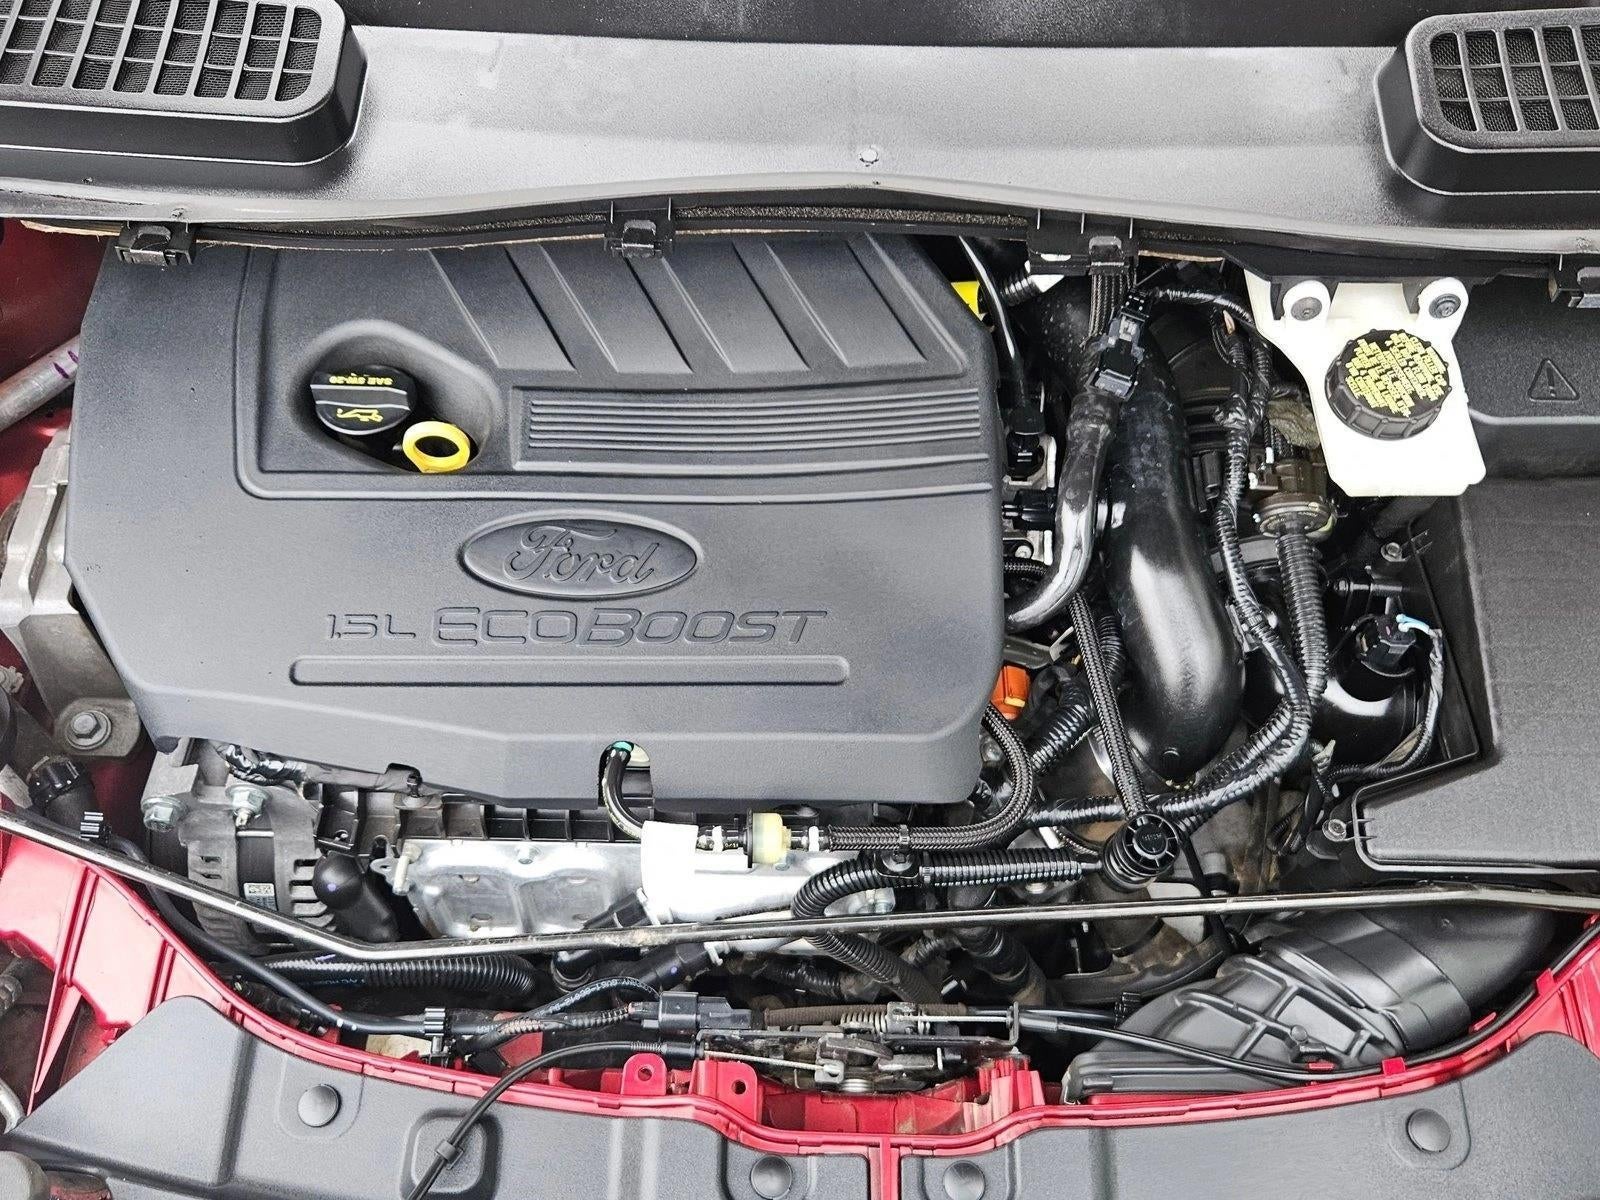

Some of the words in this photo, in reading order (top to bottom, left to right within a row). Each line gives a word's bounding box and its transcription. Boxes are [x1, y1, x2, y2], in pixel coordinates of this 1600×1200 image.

[501, 524, 661, 585] Ford
[326, 613, 416, 640] 1.5L
[430, 606, 829, 647] ECOBOOST
